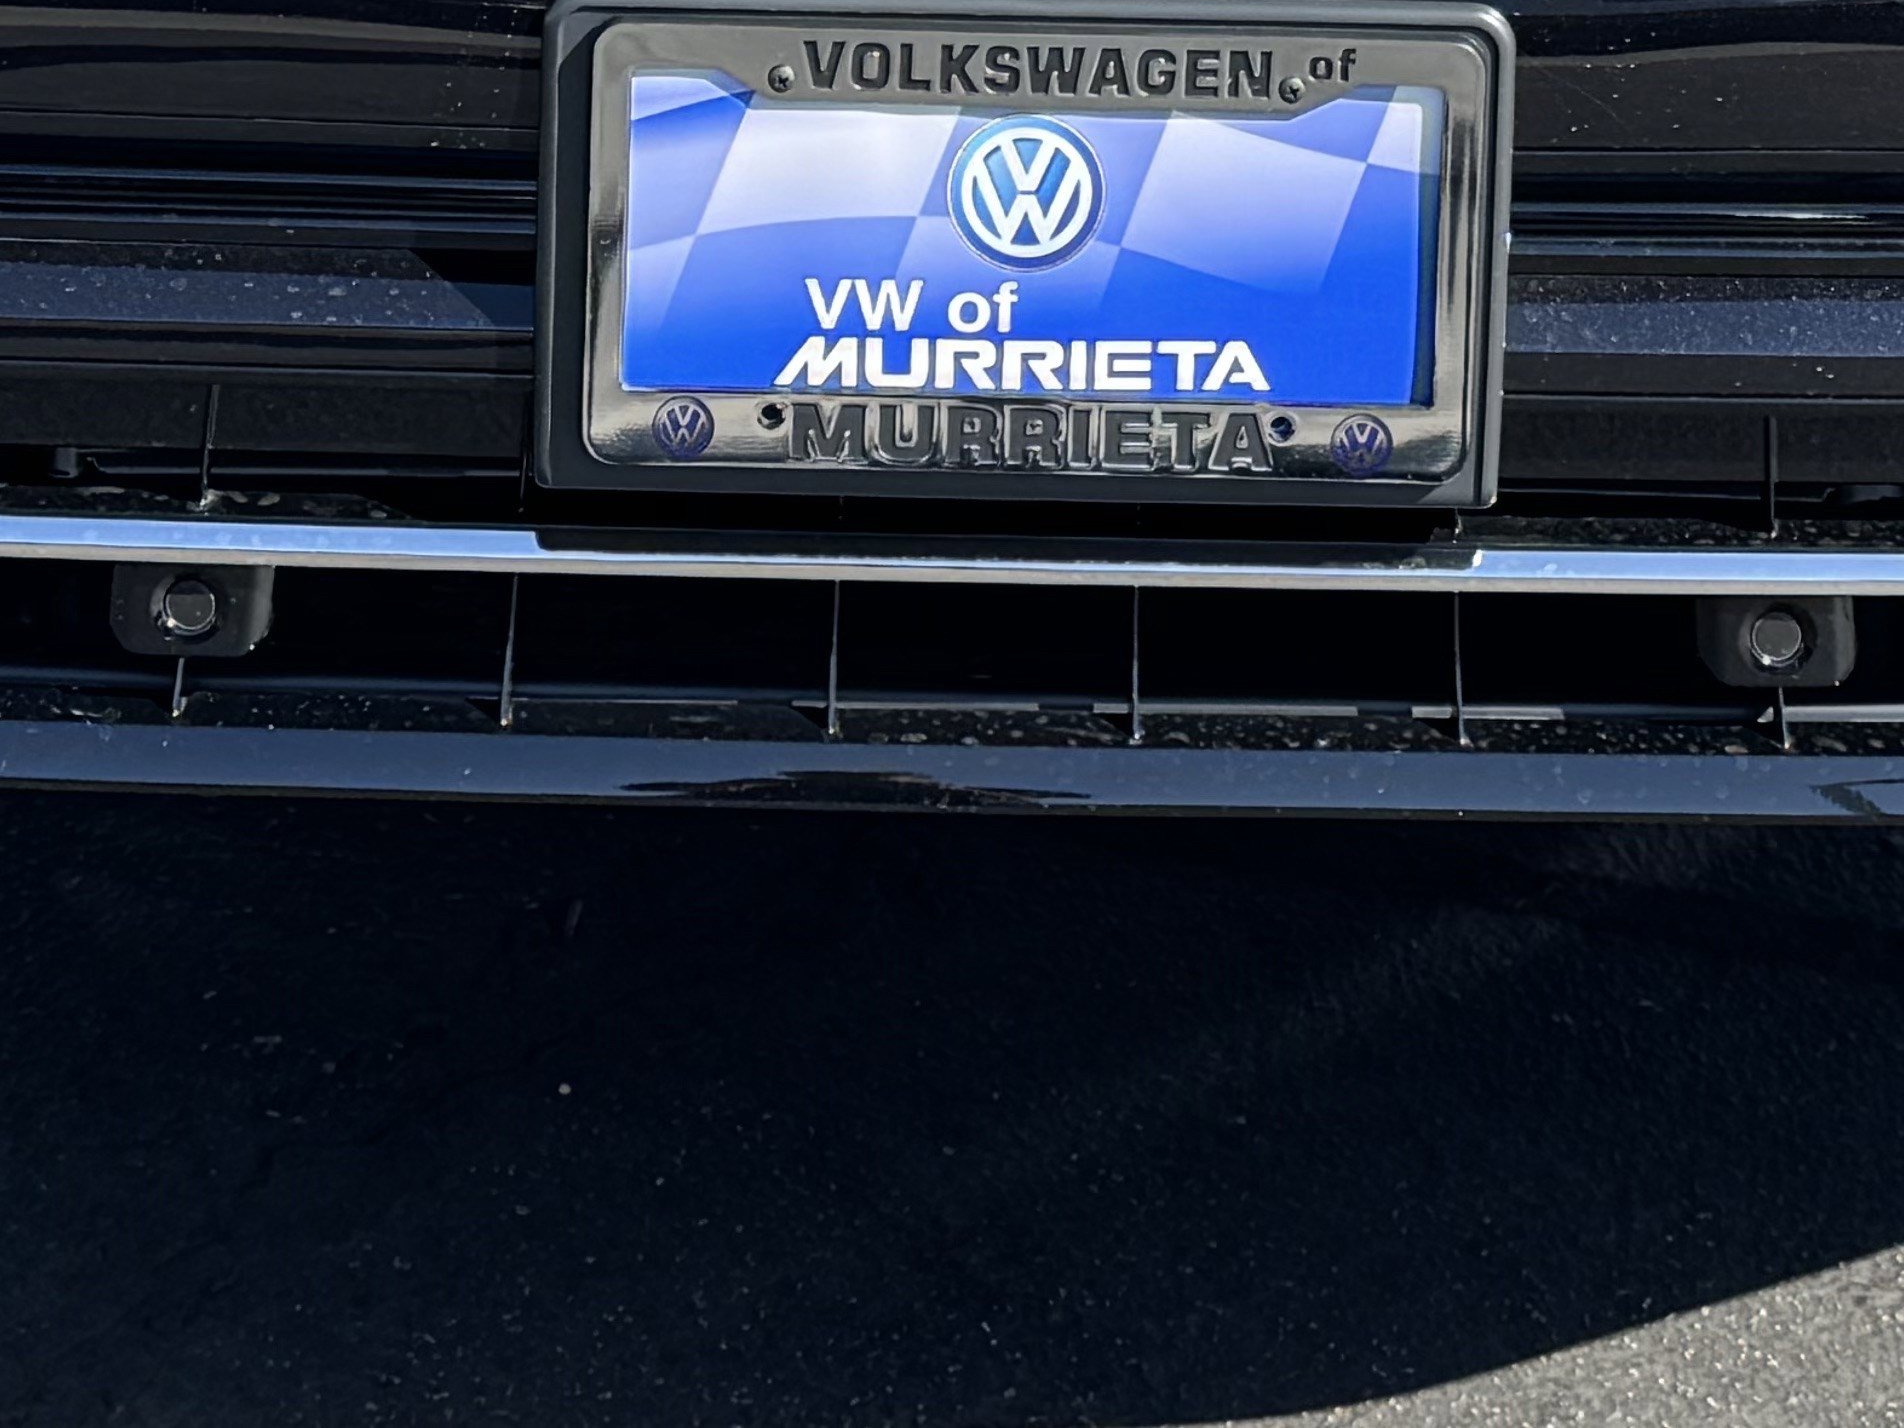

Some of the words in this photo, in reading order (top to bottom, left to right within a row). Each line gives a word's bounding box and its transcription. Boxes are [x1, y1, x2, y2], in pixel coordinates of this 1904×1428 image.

[802, 40, 1273, 100] VOLKSWAGEN
[1308, 48, 1356, 82] of
[805, 278, 924, 331] VW
[947, 281, 1019, 333] of
[773, 336, 1272, 391] MURRIETA
[788, 402, 1275, 472] MURRIETA
